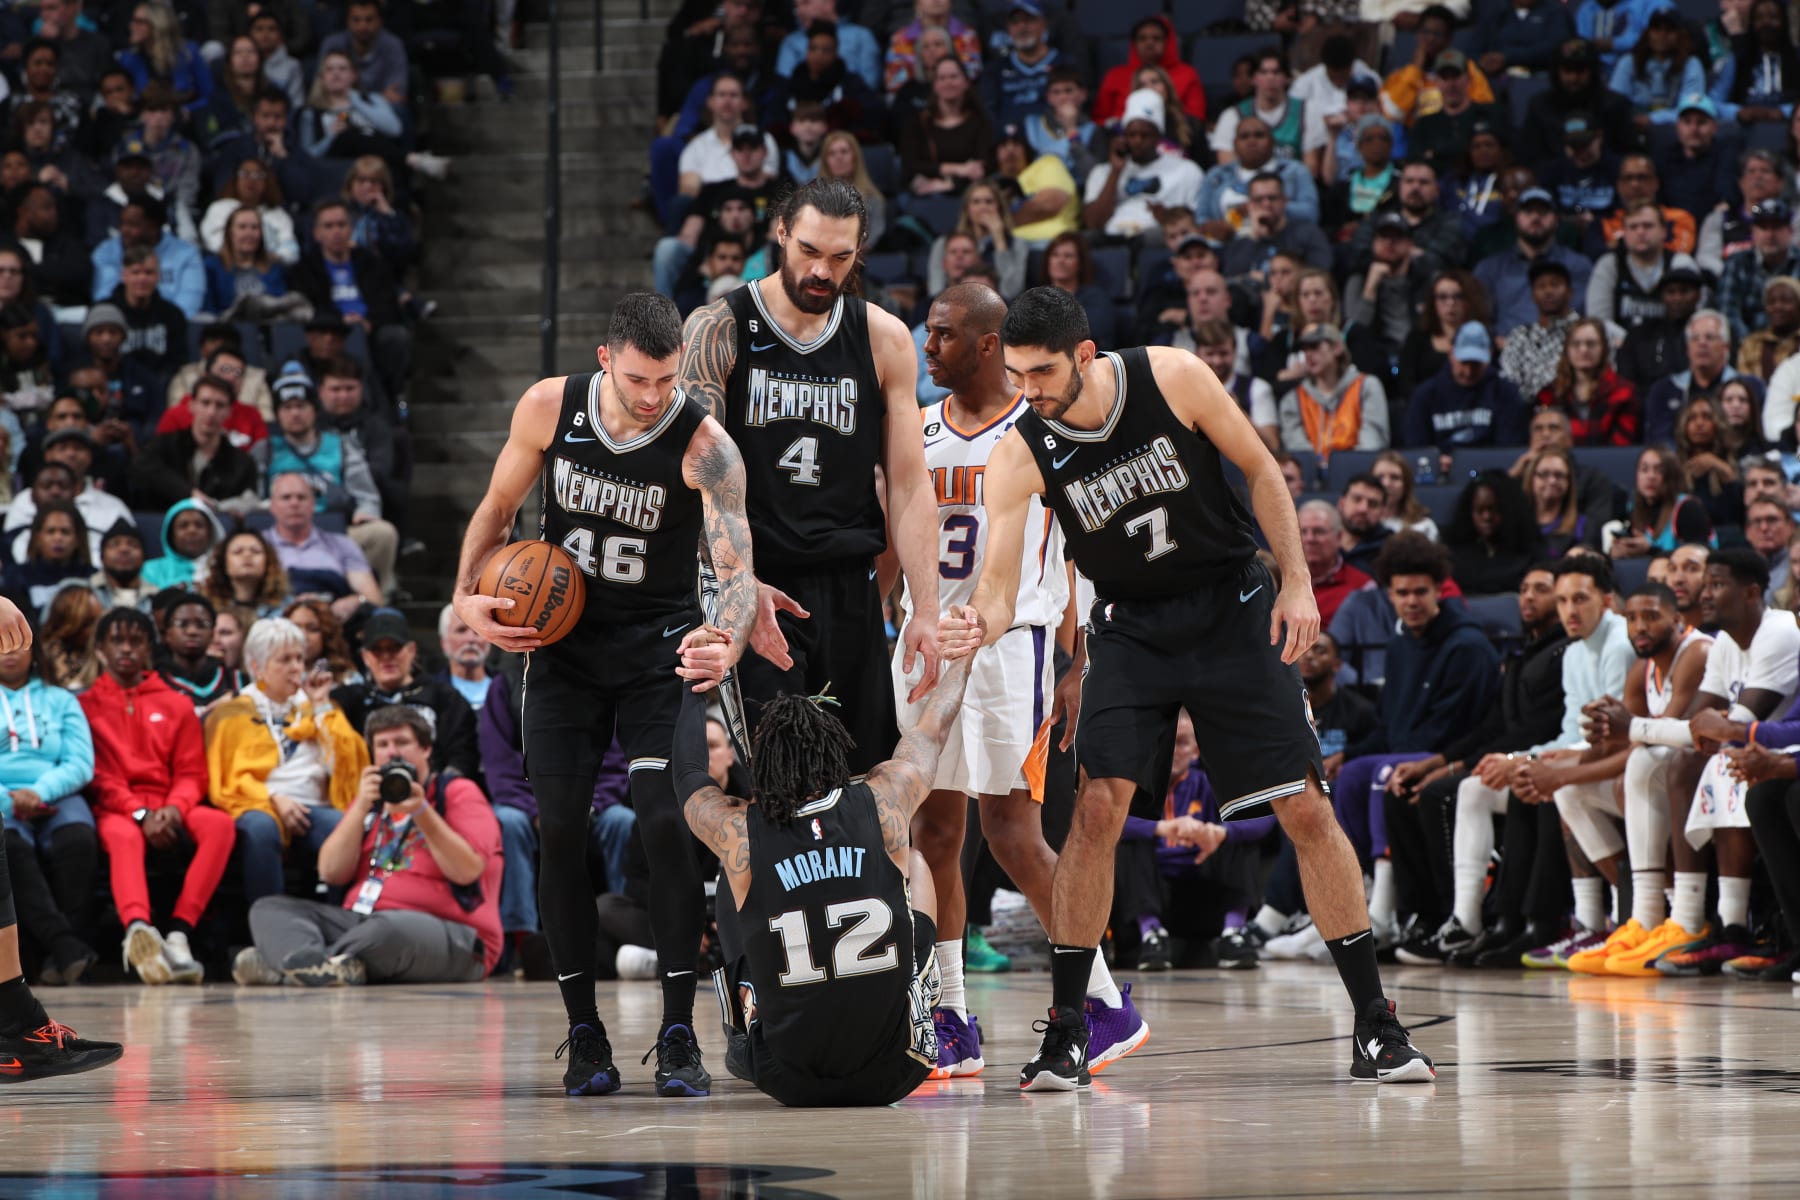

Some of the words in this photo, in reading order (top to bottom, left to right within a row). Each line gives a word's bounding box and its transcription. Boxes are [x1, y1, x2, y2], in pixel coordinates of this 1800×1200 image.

[749, 319, 759, 333] 6
[572, 411, 586, 427] 6
[745, 367, 858, 435] MEMPHIS
[927, 423, 938, 436] 6
[1043, 434, 1057, 449] 6
[776, 436, 821, 486] 4
[928, 465, 986, 507] UN
[1063, 435, 1190, 533] MEMPHIS
[553, 456, 667, 532] MEMPHIS
[561, 527, 647, 584] 46
[938, 514, 979, 580] 3
[1123, 505, 1178, 561] 7
[533, 565, 571, 632] Wilson
[775, 846, 866, 892] MORANT
[768, 897, 899, 987] 12
